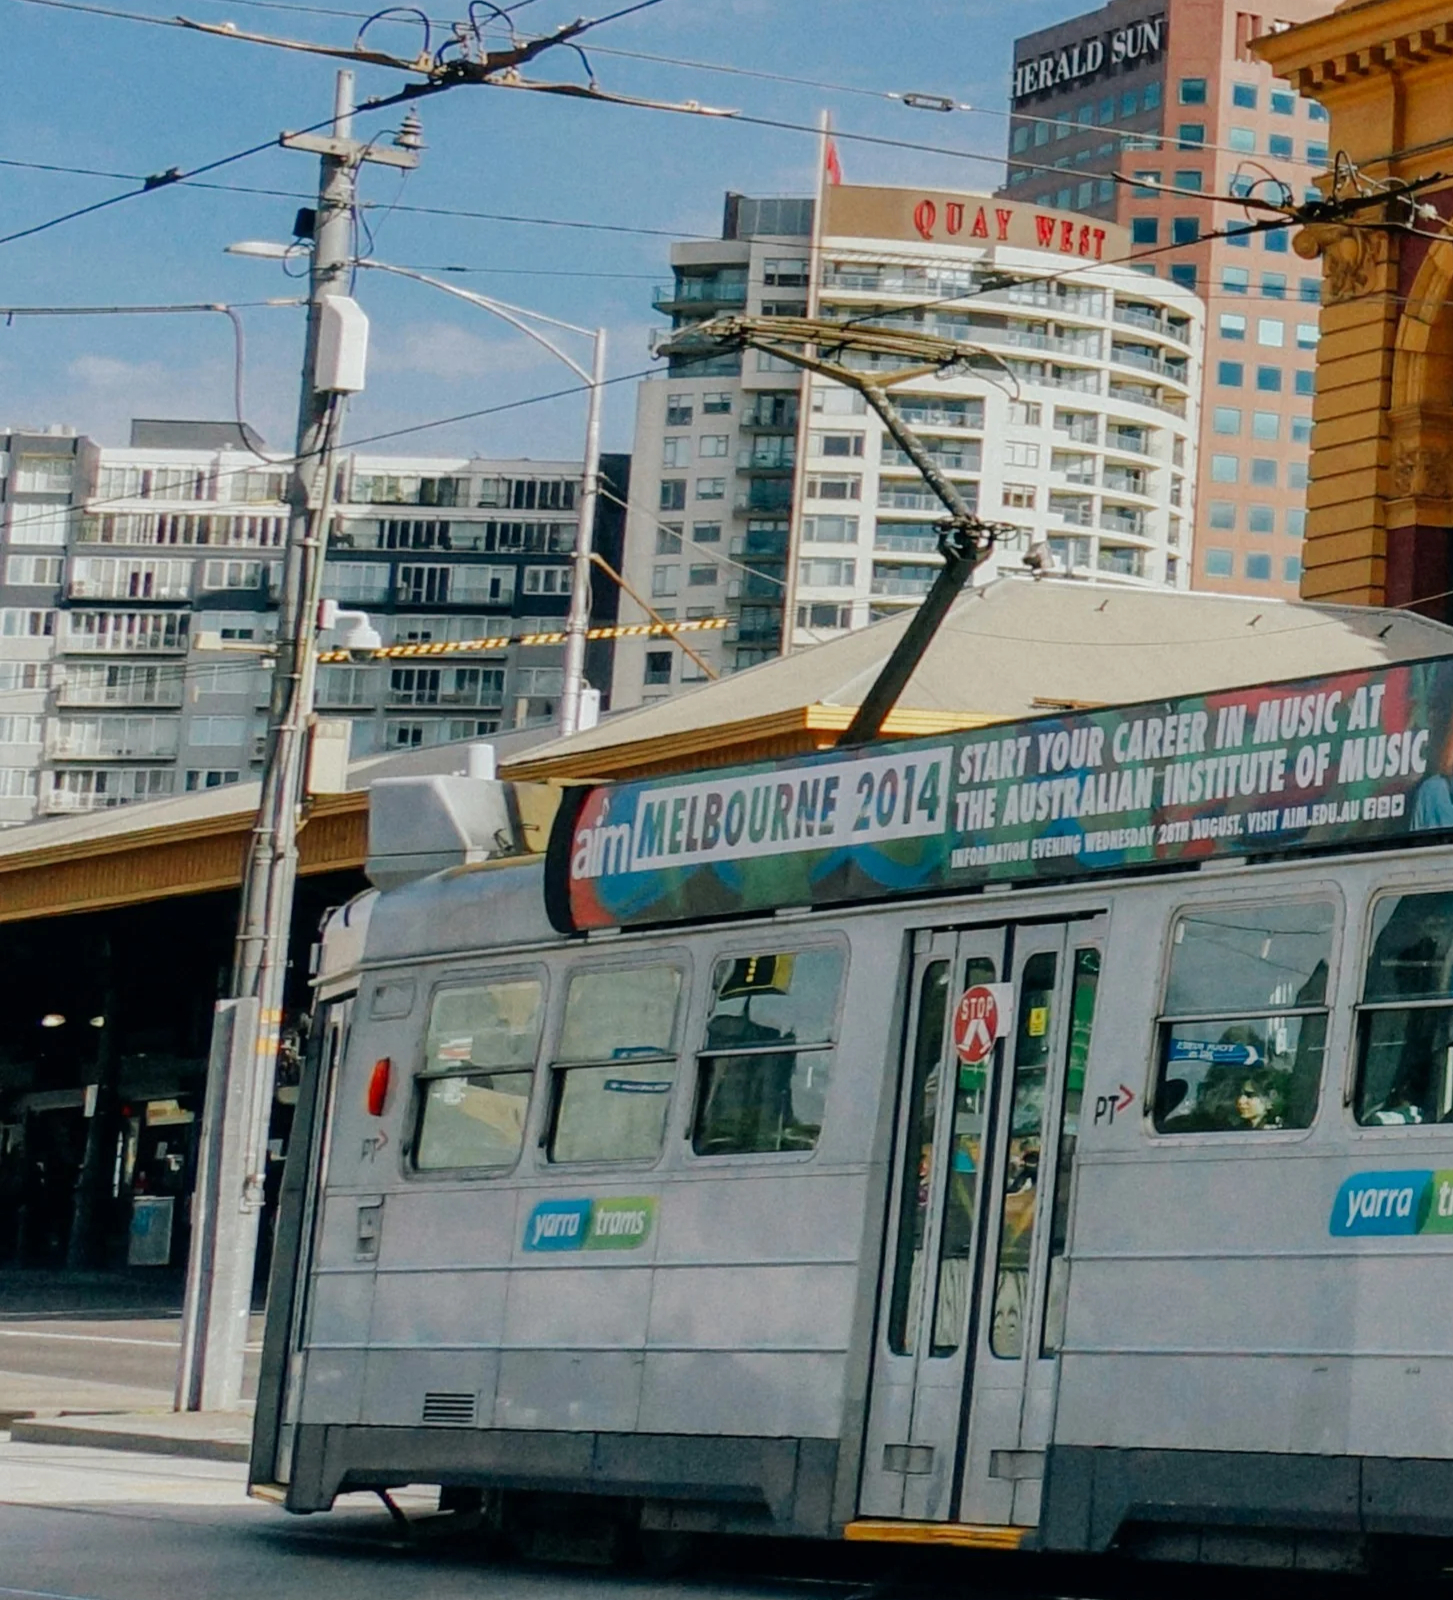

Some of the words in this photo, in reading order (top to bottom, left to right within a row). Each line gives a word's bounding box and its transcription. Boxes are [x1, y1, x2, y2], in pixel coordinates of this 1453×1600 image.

[1011, 41, 1102, 97] HERALD
[1111, 19, 1164, 63] SUN
[914, 200, 1013, 241] QUAY
[1035, 215, 1106, 260] WEST
[959, 737, 1031, 784] START
[1037, 727, 1105, 773] YOUR
[1113, 711, 1208, 763] CAREER
[1215, 705, 1246, 749] IN
[1253, 690, 1341, 744] MUSIC
[1348, 684, 1385, 731] AT
[636, 775, 840, 860] MELBOURNE
[853, 761, 942, 833] 2014
[955, 789, 996, 832] THE
[1002, 767, 1154, 826] AUSTRALIAN
[1163, 749, 1287, 806] INSTITUTE
[1295, 742, 1331, 788] OF
[1338, 729, 1430, 784] MUSIC
[572, 805, 631, 880] aim
[951, 841, 1028, 868] INFORMATION
[1031, 834, 1081, 859] EVENING
[1084, 826, 1155, 853] WEDNESDAY
[1192, 814, 1243, 840] AUGUST.
[1248, 809, 1279, 833] VISIT
[1281, 800, 1360, 829] AIM.EDU.AU
[961, 996, 994, 1021] STOP
[531, 1208, 579, 1245] yarra
[595, 1203, 646, 1236] trams
[1345, 1187, 1413, 1227] yarra
